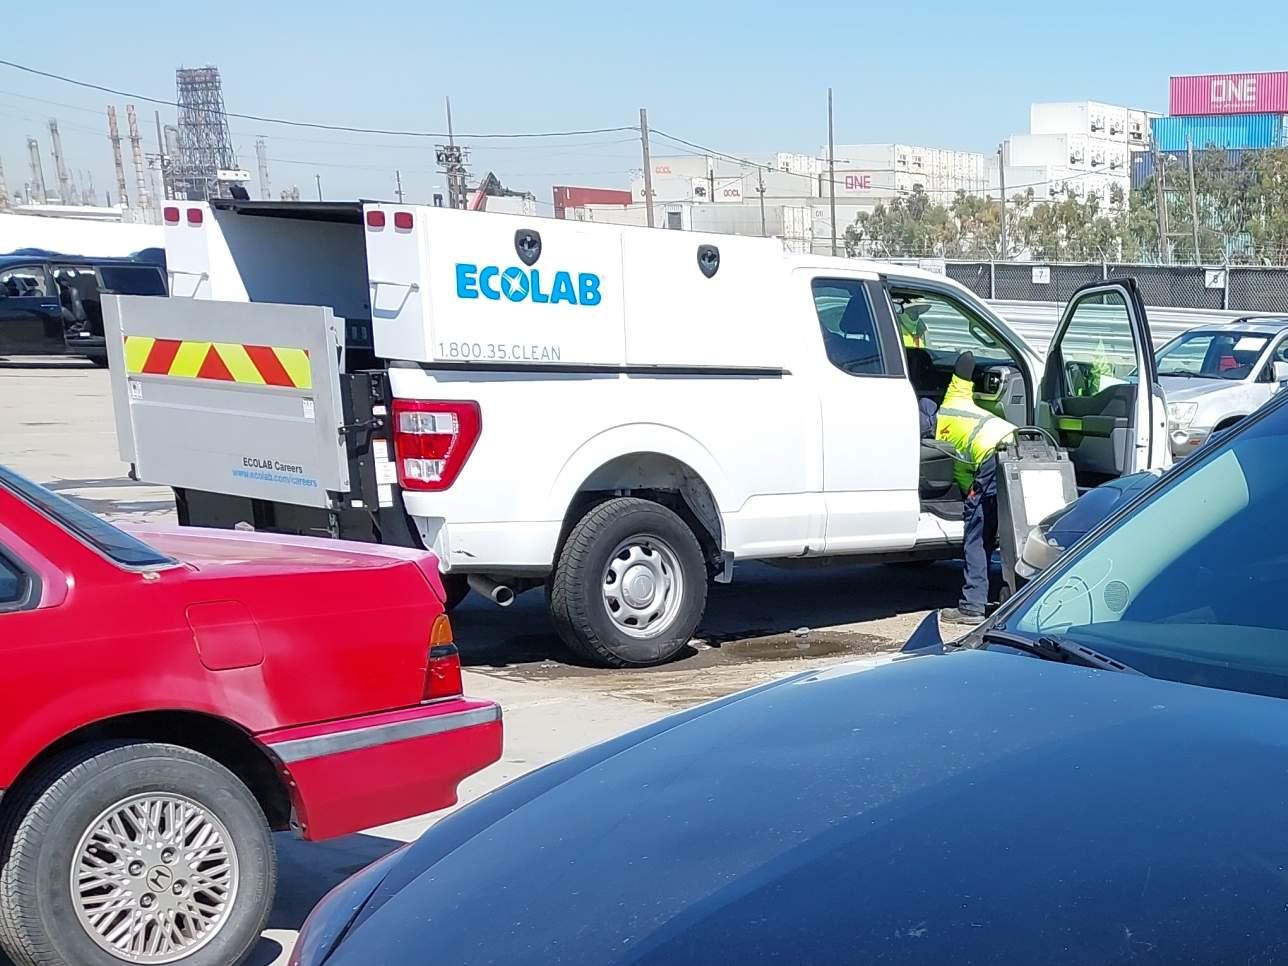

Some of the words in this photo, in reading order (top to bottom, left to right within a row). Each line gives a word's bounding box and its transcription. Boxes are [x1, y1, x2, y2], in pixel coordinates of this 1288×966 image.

[1211, 79, 1256, 101] ONE
[845, 175, 871, 189] ONE
[1039, 270, 1044, 279] 7
[455, 263, 602, 306] ECOLAB
[439, 342, 561, 361] 1.800.35.CLEAN
[243, 457, 273, 470] ECOLAB
[274, 461, 303, 474] Careers
